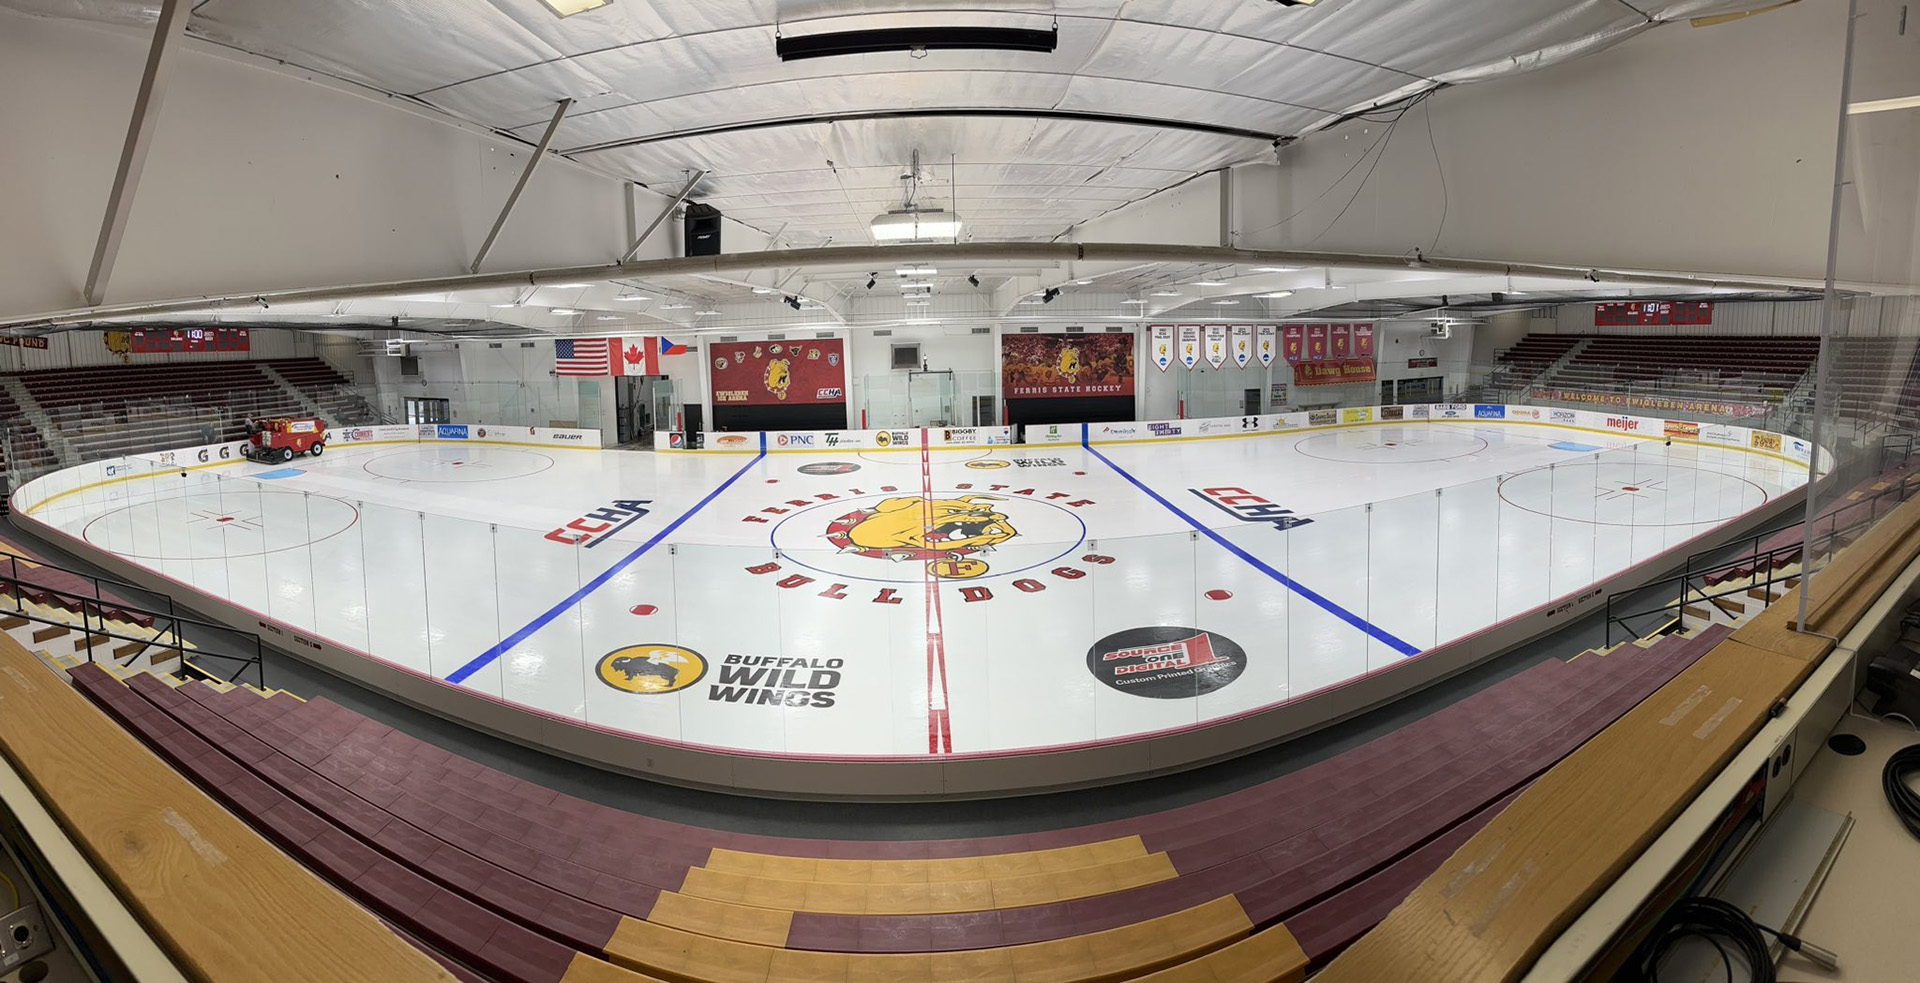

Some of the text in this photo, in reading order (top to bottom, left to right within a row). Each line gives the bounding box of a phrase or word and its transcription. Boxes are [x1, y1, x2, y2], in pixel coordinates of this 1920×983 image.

[13, 337, 46, 348] PUND
[1315, 364, 1371, 377] Dawg House
[818, 388, 842, 397] CCHA
[1563, 392, 1605, 402] WELCOME
[1609, 396, 1621, 404] TO
[1688, 403, 1726, 413] ARENA
[1477, 410, 1502, 418] AQUAFINA
[1606, 416, 1639, 431] meijer
[438, 427, 467, 437] AQUAFINA
[790, 435, 814, 445] PNC
[742, 483, 1097, 524] FERRIS STATE
[1202, 487, 1315, 531] CCHA
[544, 499, 653, 545] CCHA
[1103, 643, 1183, 661] SOURCE
[723, 654, 844, 669] BUFFALO
[1115, 659, 1187, 675] DIGITAL
[718, 664, 842, 689] WILD
[1115, 676, 1157, 686] Custom
[1157, 669, 1194, 680] Printed
[708, 684, 836, 709] WINGS
